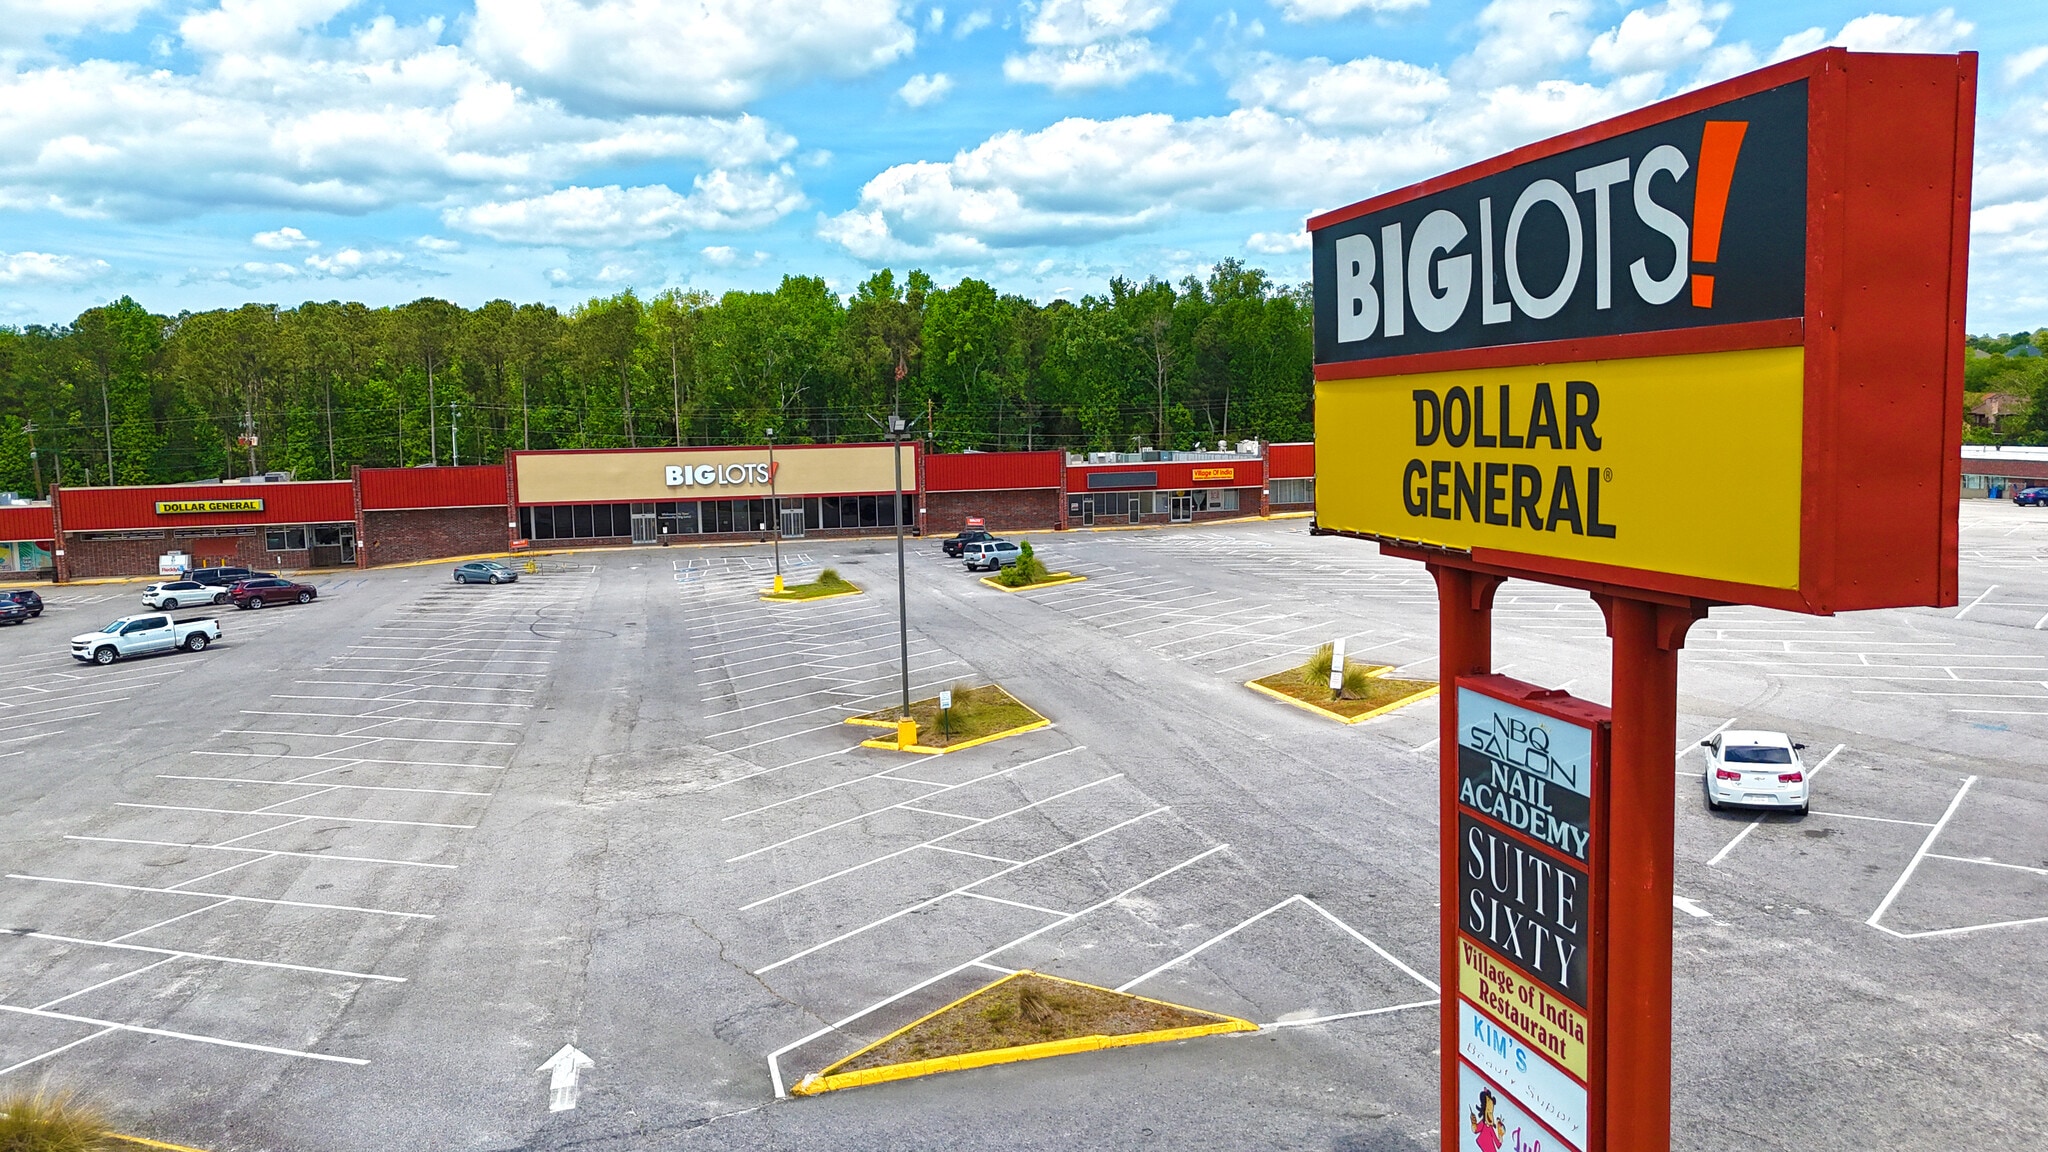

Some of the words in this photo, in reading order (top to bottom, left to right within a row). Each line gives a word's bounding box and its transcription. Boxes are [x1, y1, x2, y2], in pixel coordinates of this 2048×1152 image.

[1412, 381, 1602, 452] DOLLAR
[163, 503, 206, 512] DOLLAR
[208, 501, 256, 510] GENERAL
[1471, 726, 1576, 789] SALON
[1493, 712, 1550, 753] NBQ
[1459, 777, 1590, 860] ACADEMY
[1490, 760, 1552, 812] NAIL
[1468, 826, 1577, 934] SUITE
[1469, 888, 1577, 989] SIXTY
[1463, 941, 1514, 994] Village
[1518, 984, 1535, 1010] of
[1539, 991, 1584, 1045] India
[1479, 977, 1566, 1060] Restaurant
[1474, 1015, 1527, 1074] KIM'S
